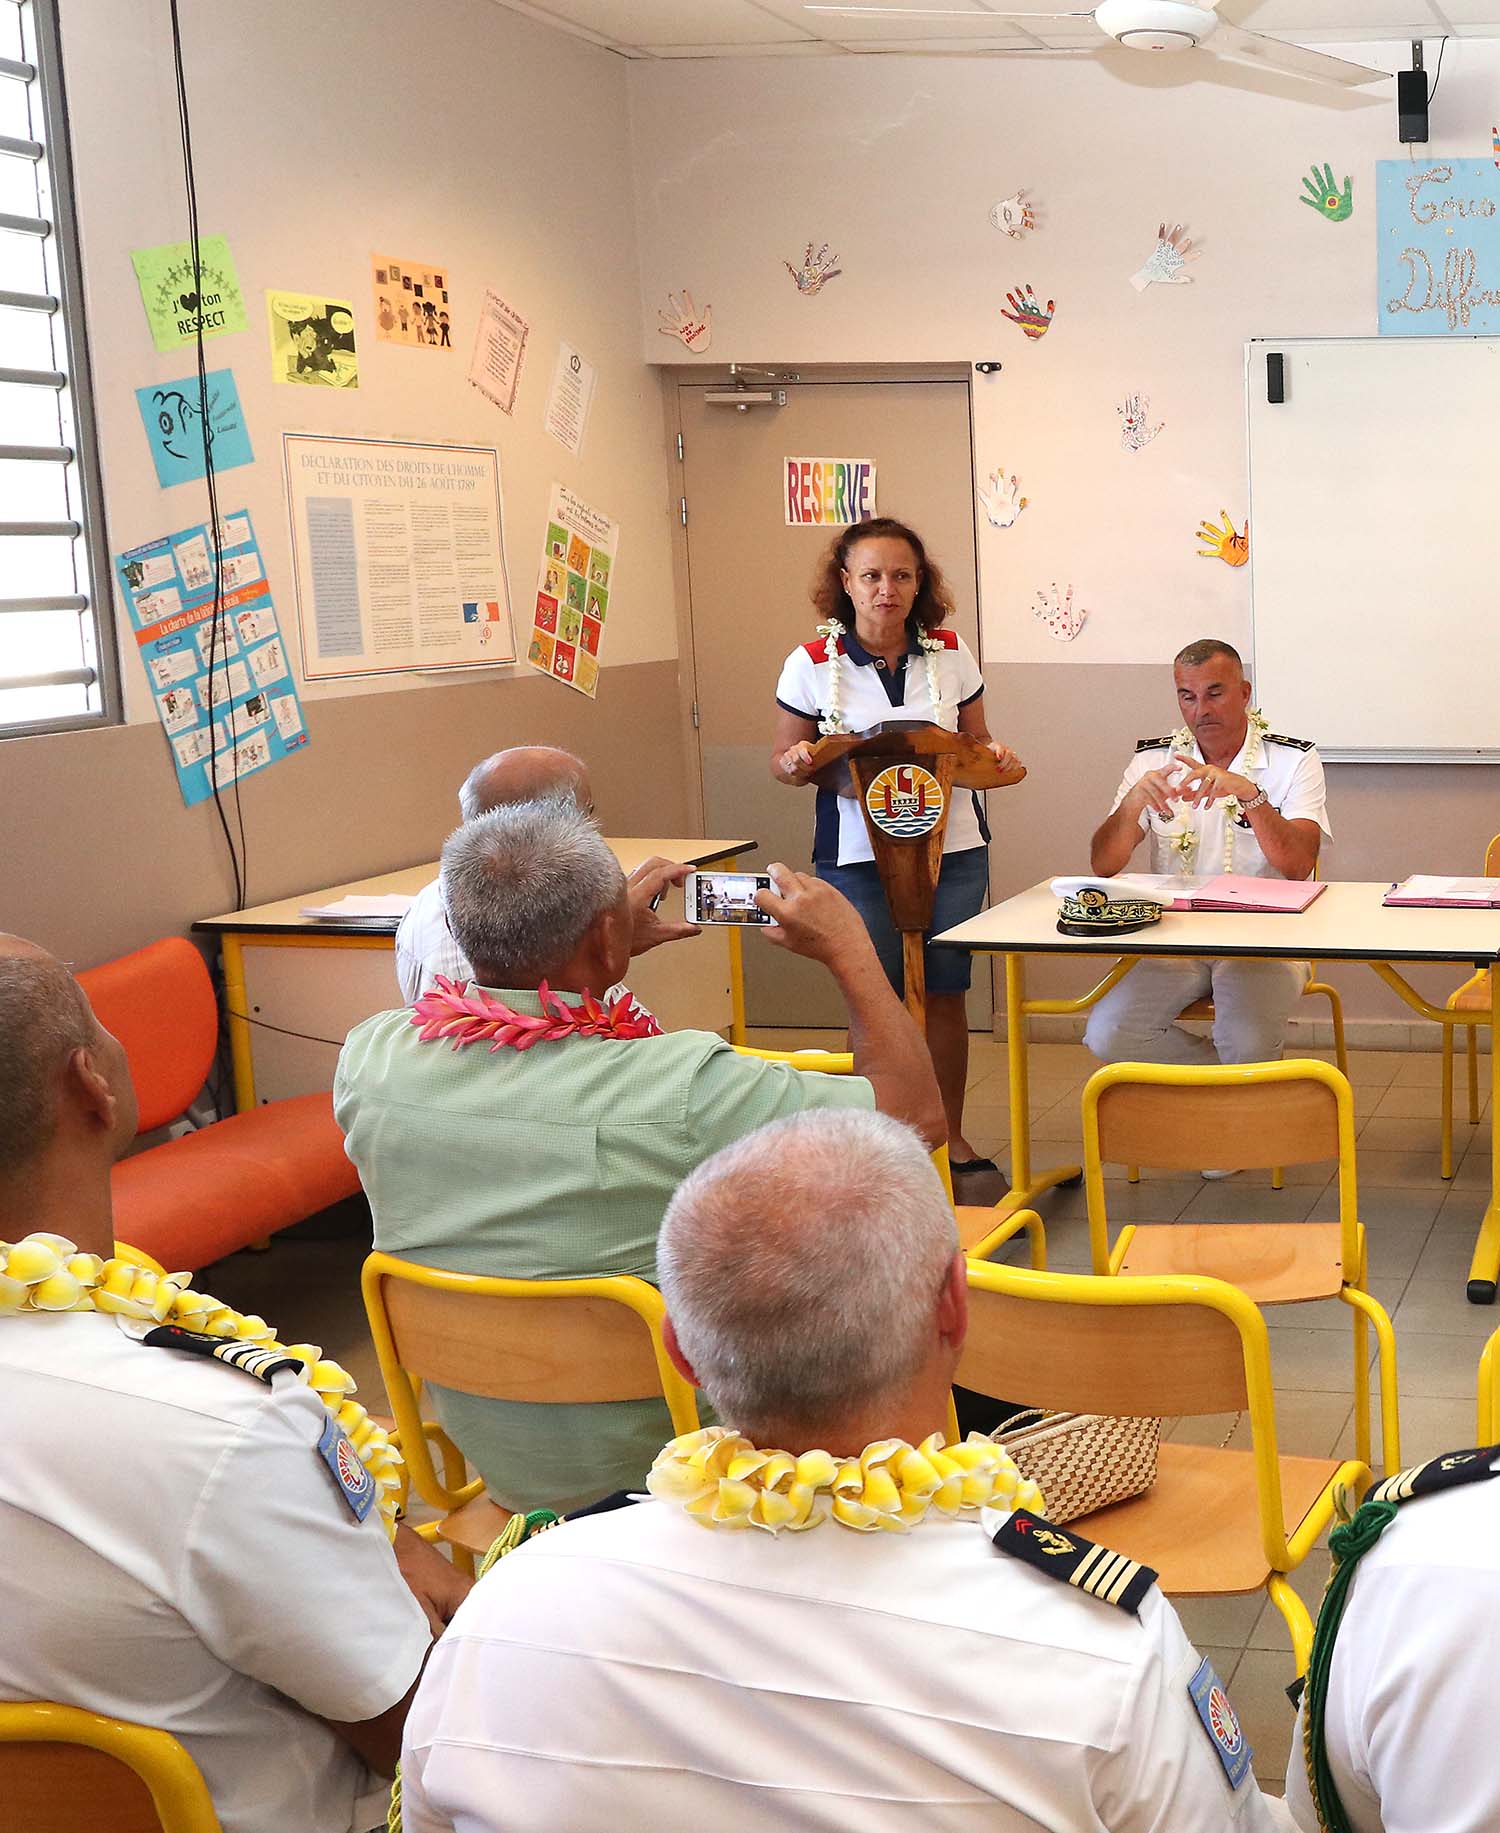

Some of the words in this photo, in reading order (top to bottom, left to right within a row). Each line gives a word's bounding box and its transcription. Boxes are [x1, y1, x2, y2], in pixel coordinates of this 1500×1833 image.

[201, 293, 222, 307] ton
[177, 310, 226, 335] RESPECT
[376, 459, 395, 472] DES
[397, 460, 431, 475] DROITS
[433, 463, 445, 475] DE
[318, 472, 331, 485] ET
[333, 473, 350, 486] DU
[352, 474, 396, 488] CITOYEN
[399, 476, 414, 488] DU
[417, 478, 426, 489] 26
[457, 479, 476, 491] 1789
[788, 462, 871, 523] RESERVE
